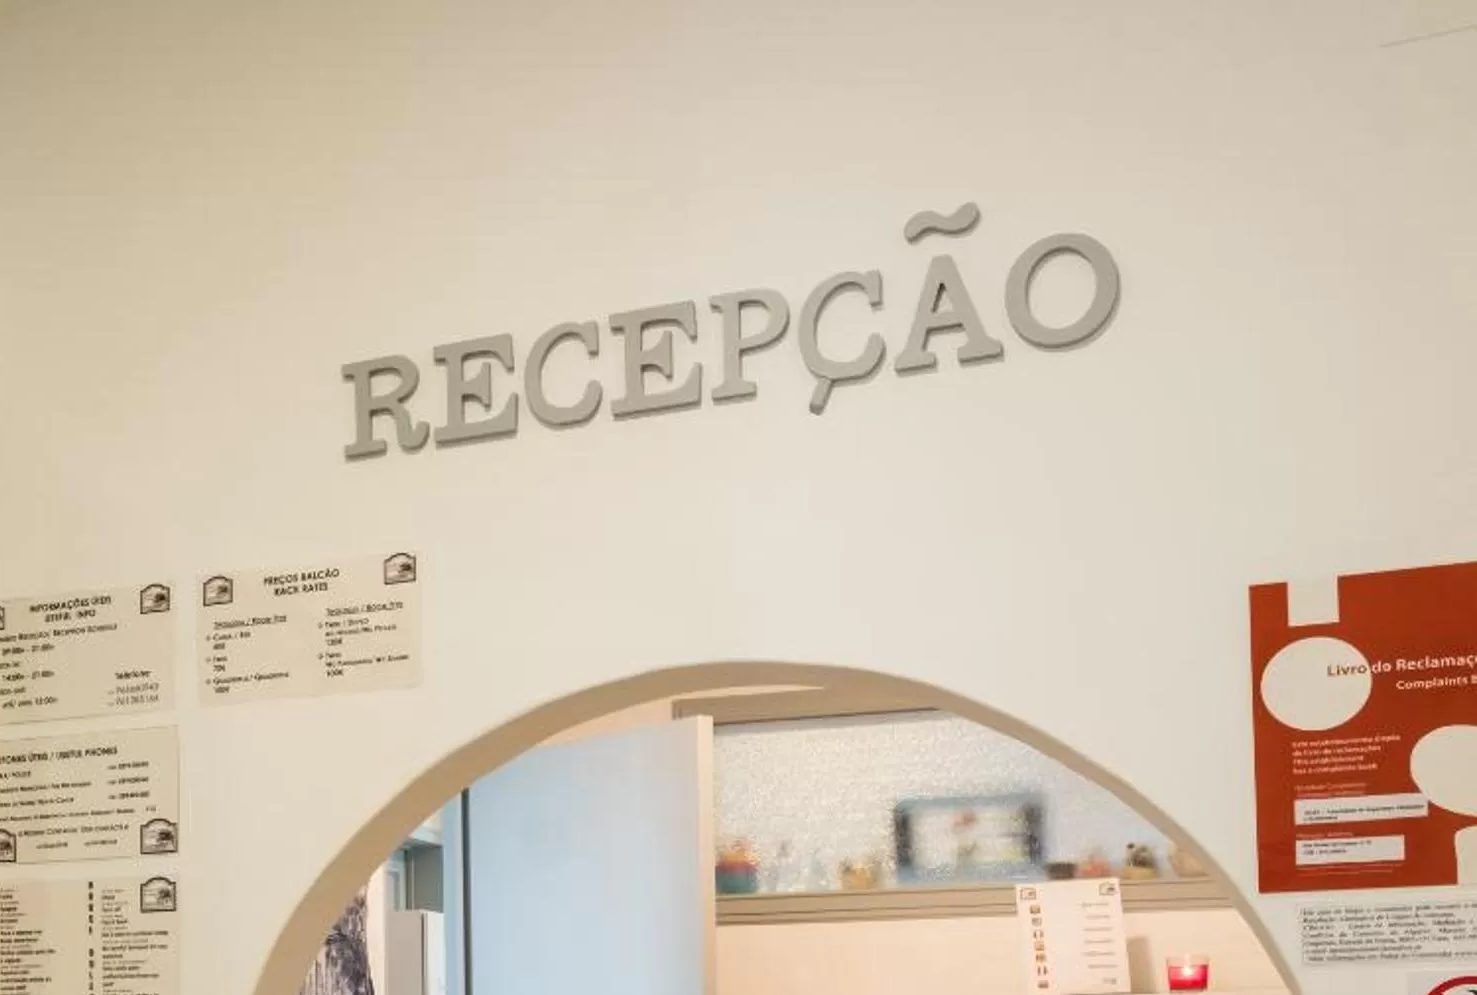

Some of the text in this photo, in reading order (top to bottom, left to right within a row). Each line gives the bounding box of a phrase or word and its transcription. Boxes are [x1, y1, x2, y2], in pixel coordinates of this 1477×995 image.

[342, 202, 1121, 460] RECEPÇÃO
[264, 574, 298, 586] PREÇOS
[1327, 664, 1368, 677] Livro
[1395, 676, 1468, 690] Complaints
